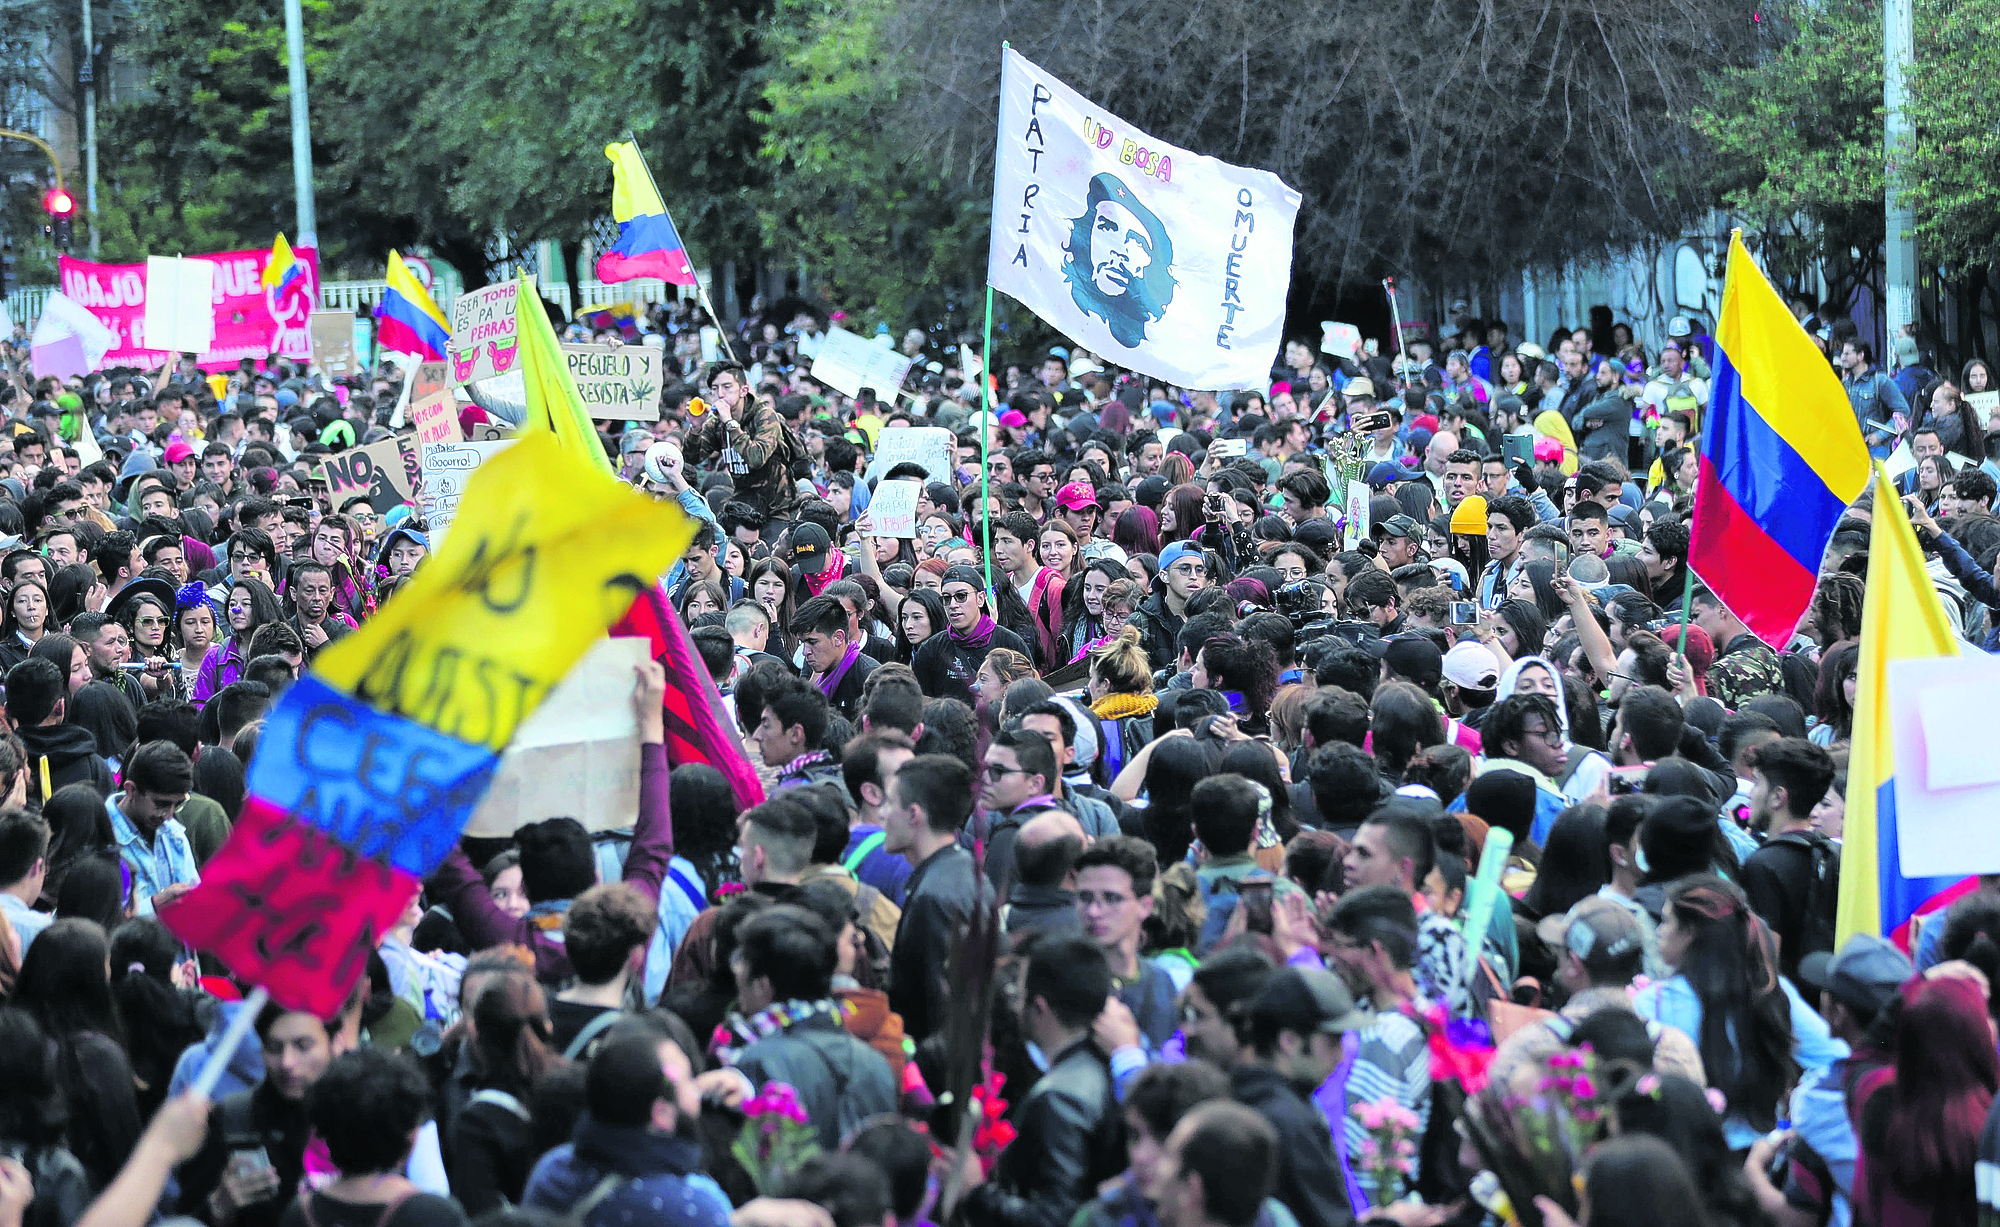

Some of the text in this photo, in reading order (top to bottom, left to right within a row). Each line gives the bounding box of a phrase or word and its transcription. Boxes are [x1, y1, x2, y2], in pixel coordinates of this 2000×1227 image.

[1084, 116, 1171, 181] UD BOSA
[1012, 83, 1052, 268] PATRIA
[457, 317, 469, 333] ES
[471, 318, 515, 343] PERRAS
[577, 382, 629, 405] RESISTA
[325, 452, 373, 492] NO
[429, 453, 471, 467] ¡Socorro!
